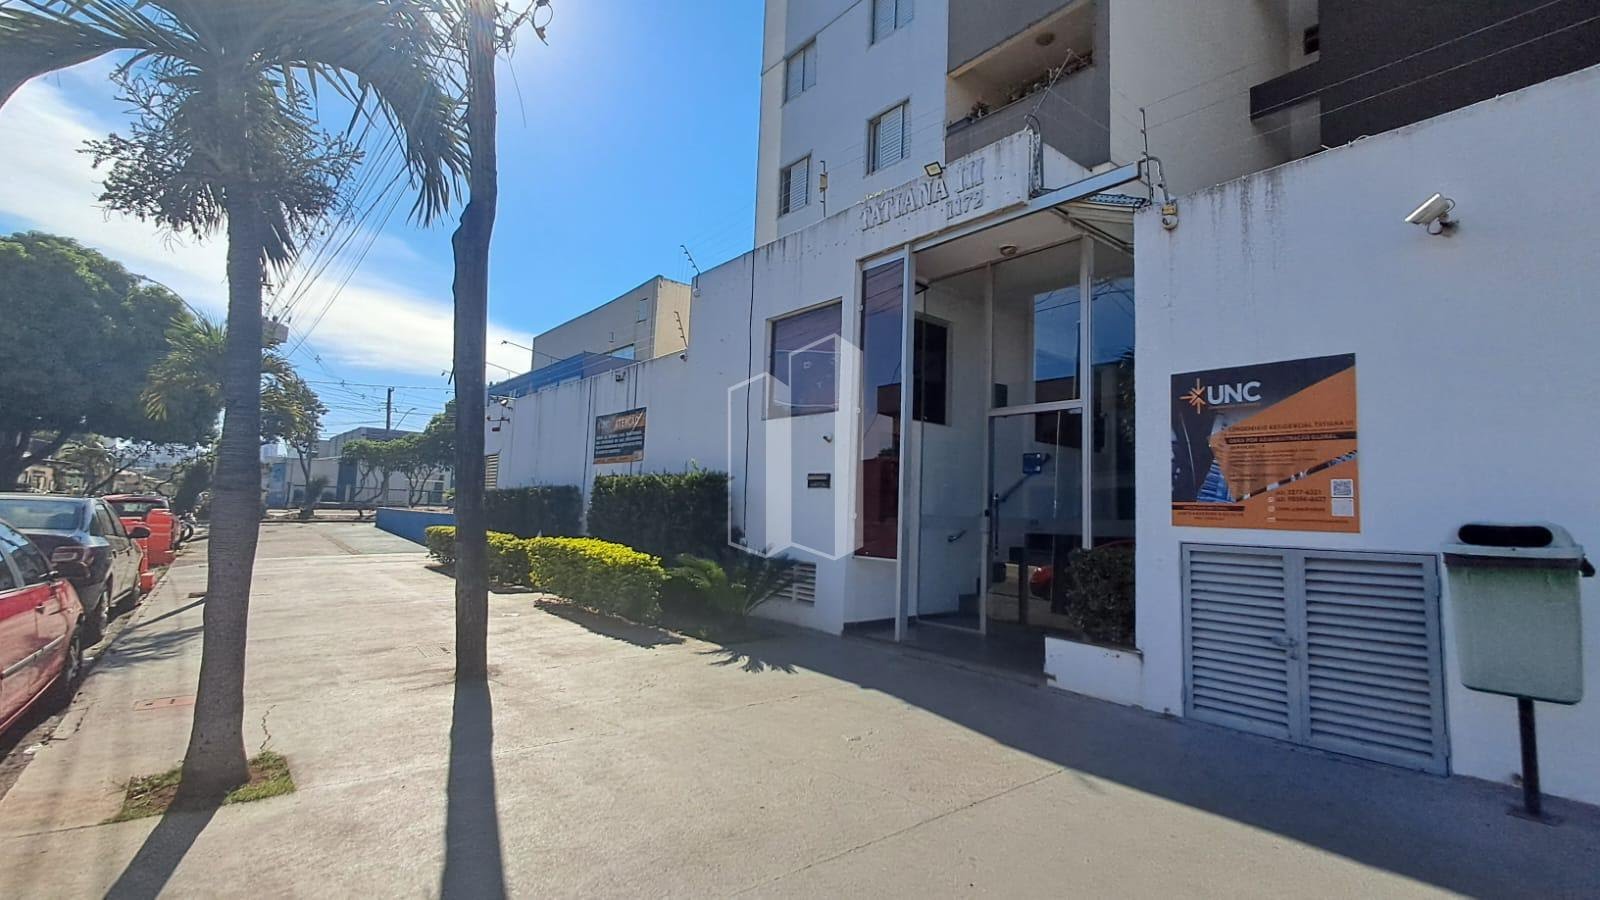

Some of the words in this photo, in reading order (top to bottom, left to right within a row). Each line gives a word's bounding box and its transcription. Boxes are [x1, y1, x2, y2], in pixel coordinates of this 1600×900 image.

[859, 177, 949, 231] TATIANA
[956, 157, 984, 194] III
[1207, 381, 1261, 405] UNC
